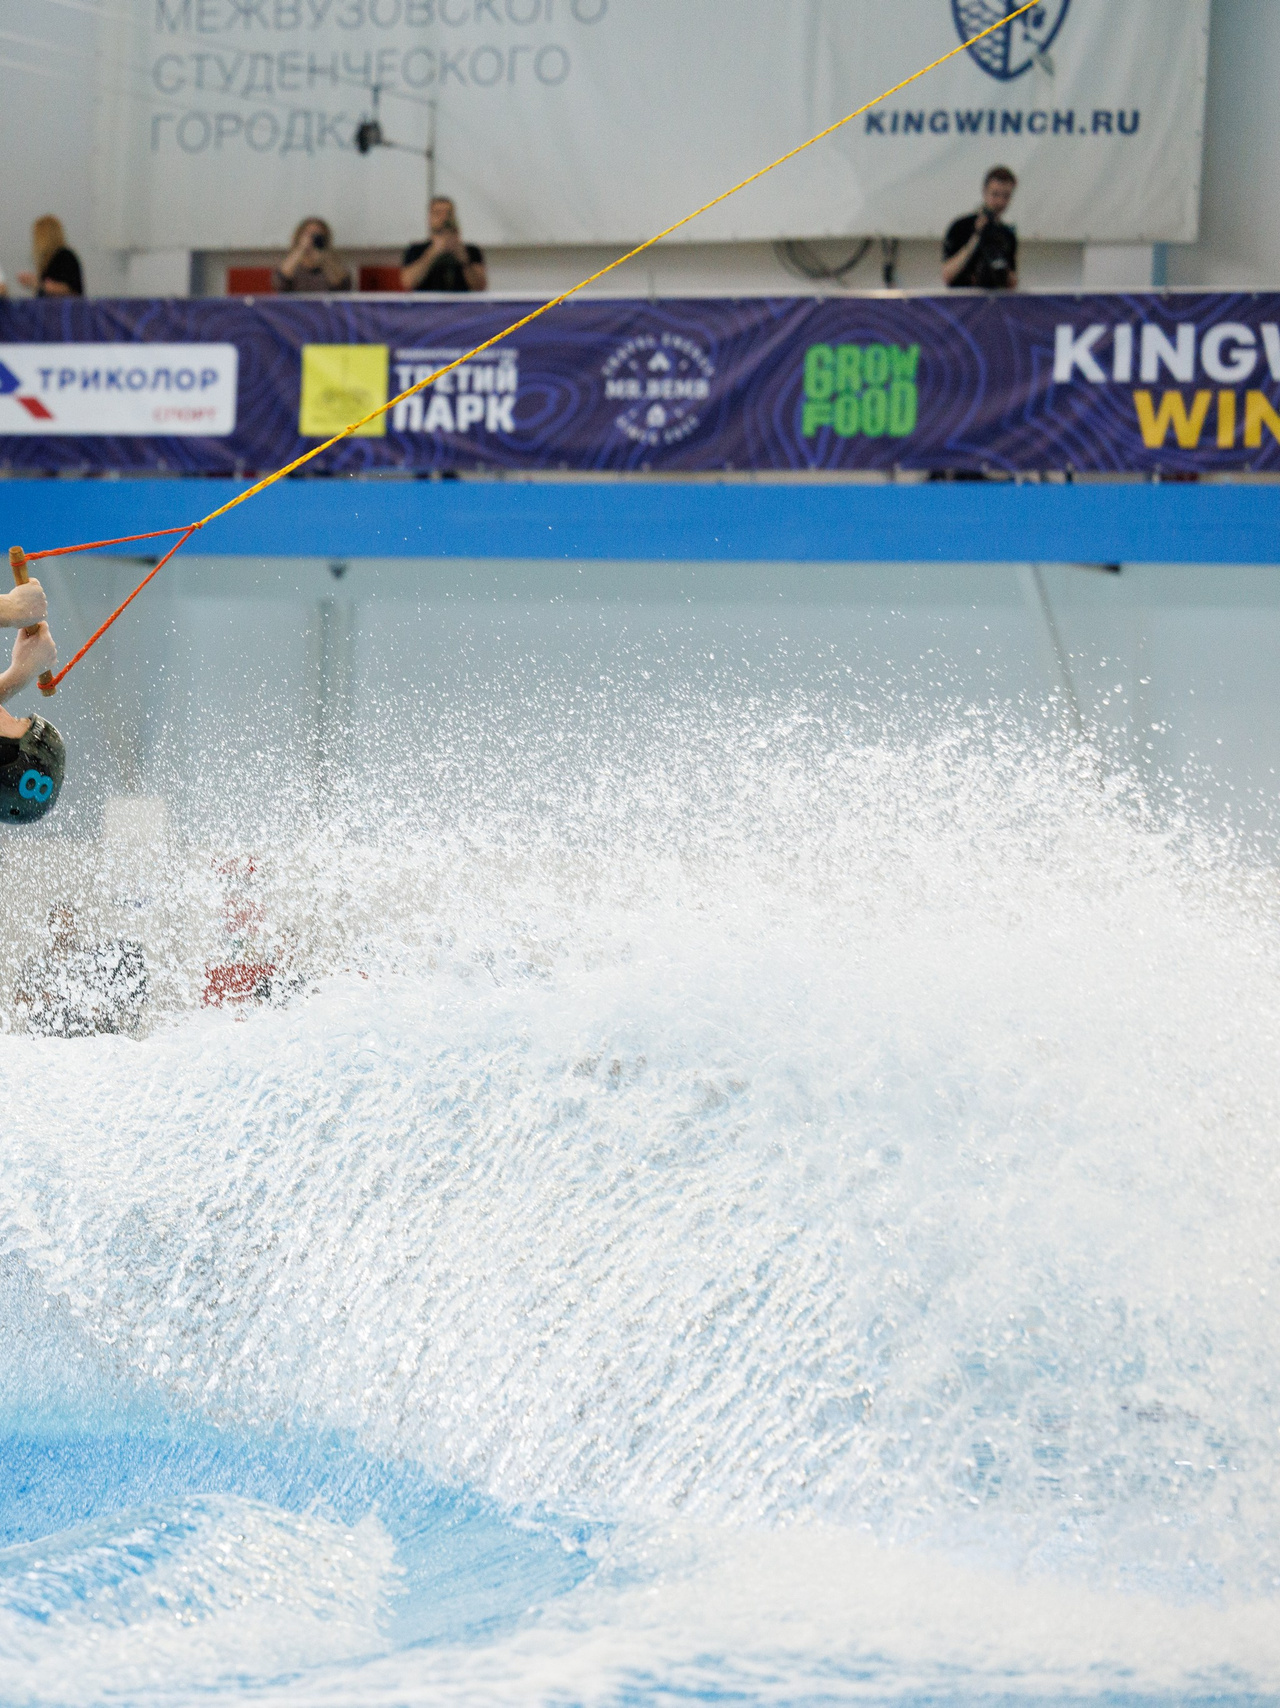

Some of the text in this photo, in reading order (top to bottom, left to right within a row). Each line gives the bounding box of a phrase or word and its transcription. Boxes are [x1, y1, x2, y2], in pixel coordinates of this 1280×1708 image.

[152, 44, 570, 97] СТУДЕНЧЕСКОГО
[865, 109, 1141, 136] KINGWINCH.RU
[38, 366, 219, 392] ТРИКОЛОР
[804, 343, 919, 400] GROW
[1053, 323, 1280, 383] KING
[392, 394, 516, 434] ПАРК
[801, 381, 918, 438] FOOD
